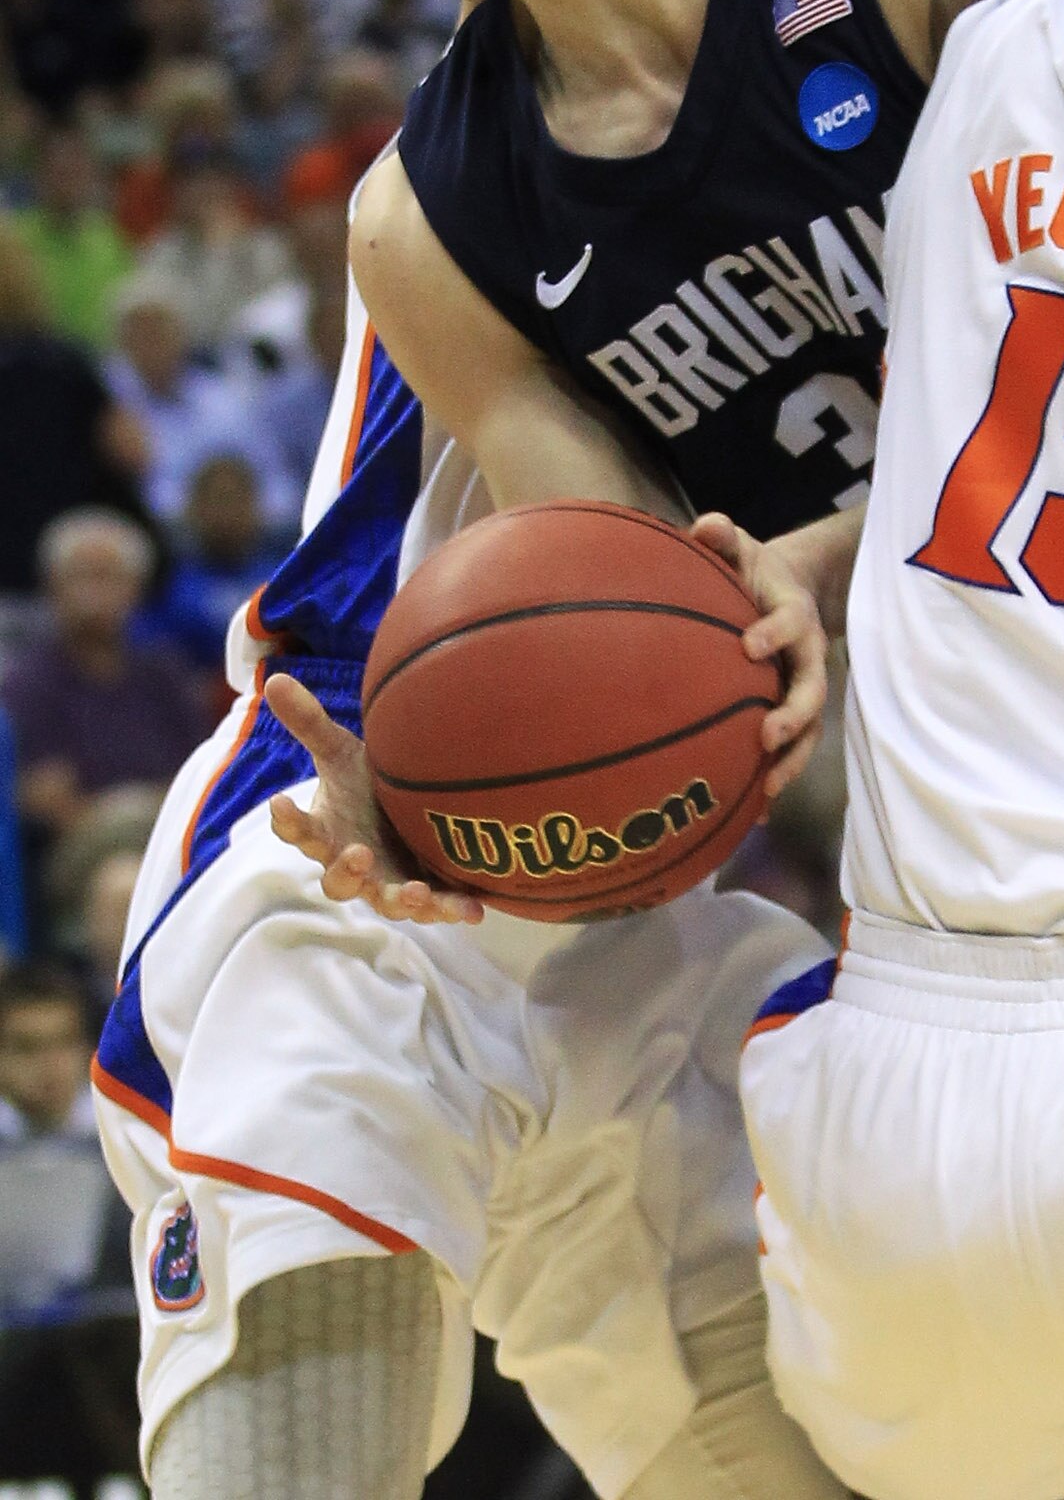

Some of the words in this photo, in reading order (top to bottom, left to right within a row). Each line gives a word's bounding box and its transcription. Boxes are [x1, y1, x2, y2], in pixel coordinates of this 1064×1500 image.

[813, 93, 871, 137] NCAA
[586, 204, 890, 438] BRIGHA
[426, 777, 720, 879] Wilson
